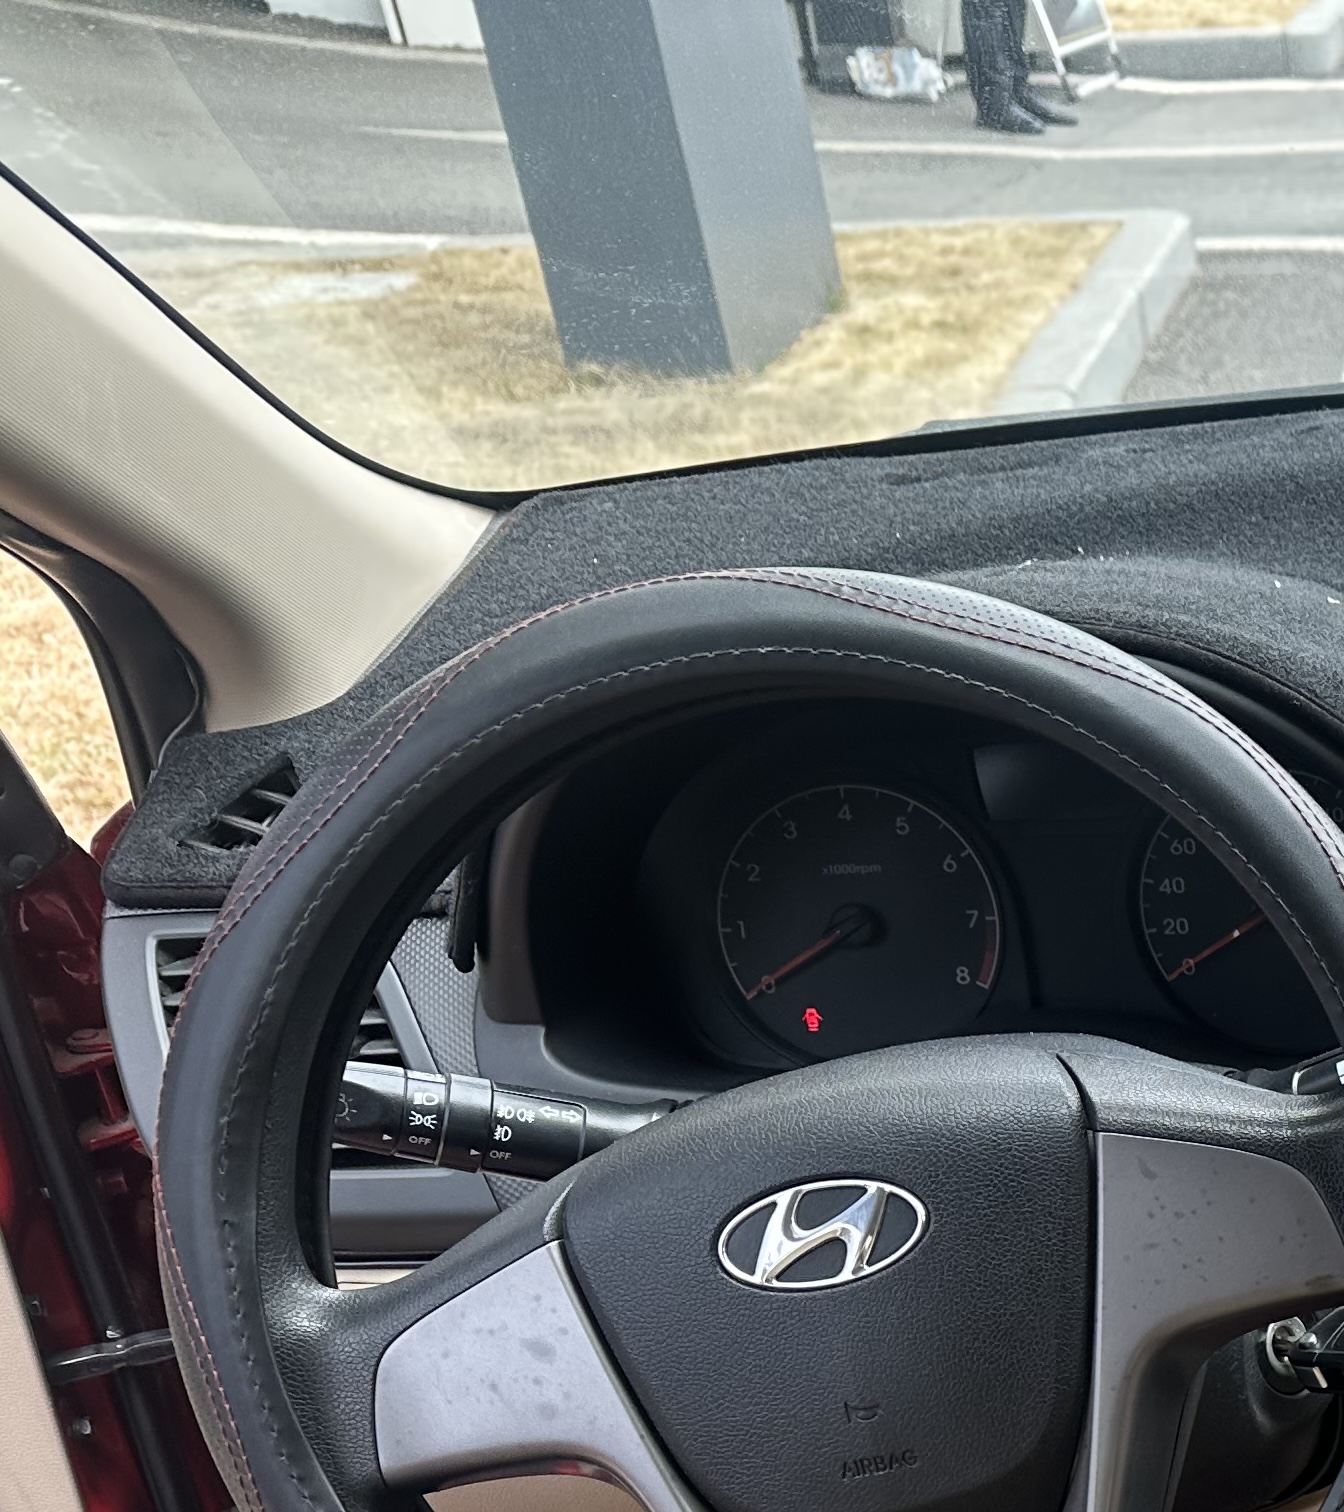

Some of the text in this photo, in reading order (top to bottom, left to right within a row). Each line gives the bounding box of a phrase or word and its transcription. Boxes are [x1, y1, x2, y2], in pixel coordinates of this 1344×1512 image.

[838, 803, 853, 821] 4
[783, 821, 797, 840] 3
[895, 816, 910, 836] 5
[1170, 838, 1197, 856] 60
[747, 864, 761, 882] 2
[943, 854, 957, 874] 6
[1159, 876, 1186, 895] 40
[965, 910, 979, 929] 7
[1163, 917, 1190, 936] 20
[736, 920, 746, 940] 1
[955, 966, 971, 985] 8
[408, 1135, 432, 1147] OFF
[489, 1149, 513, 1161] OFF
[841, 1449, 919, 1480] AIRBAG
